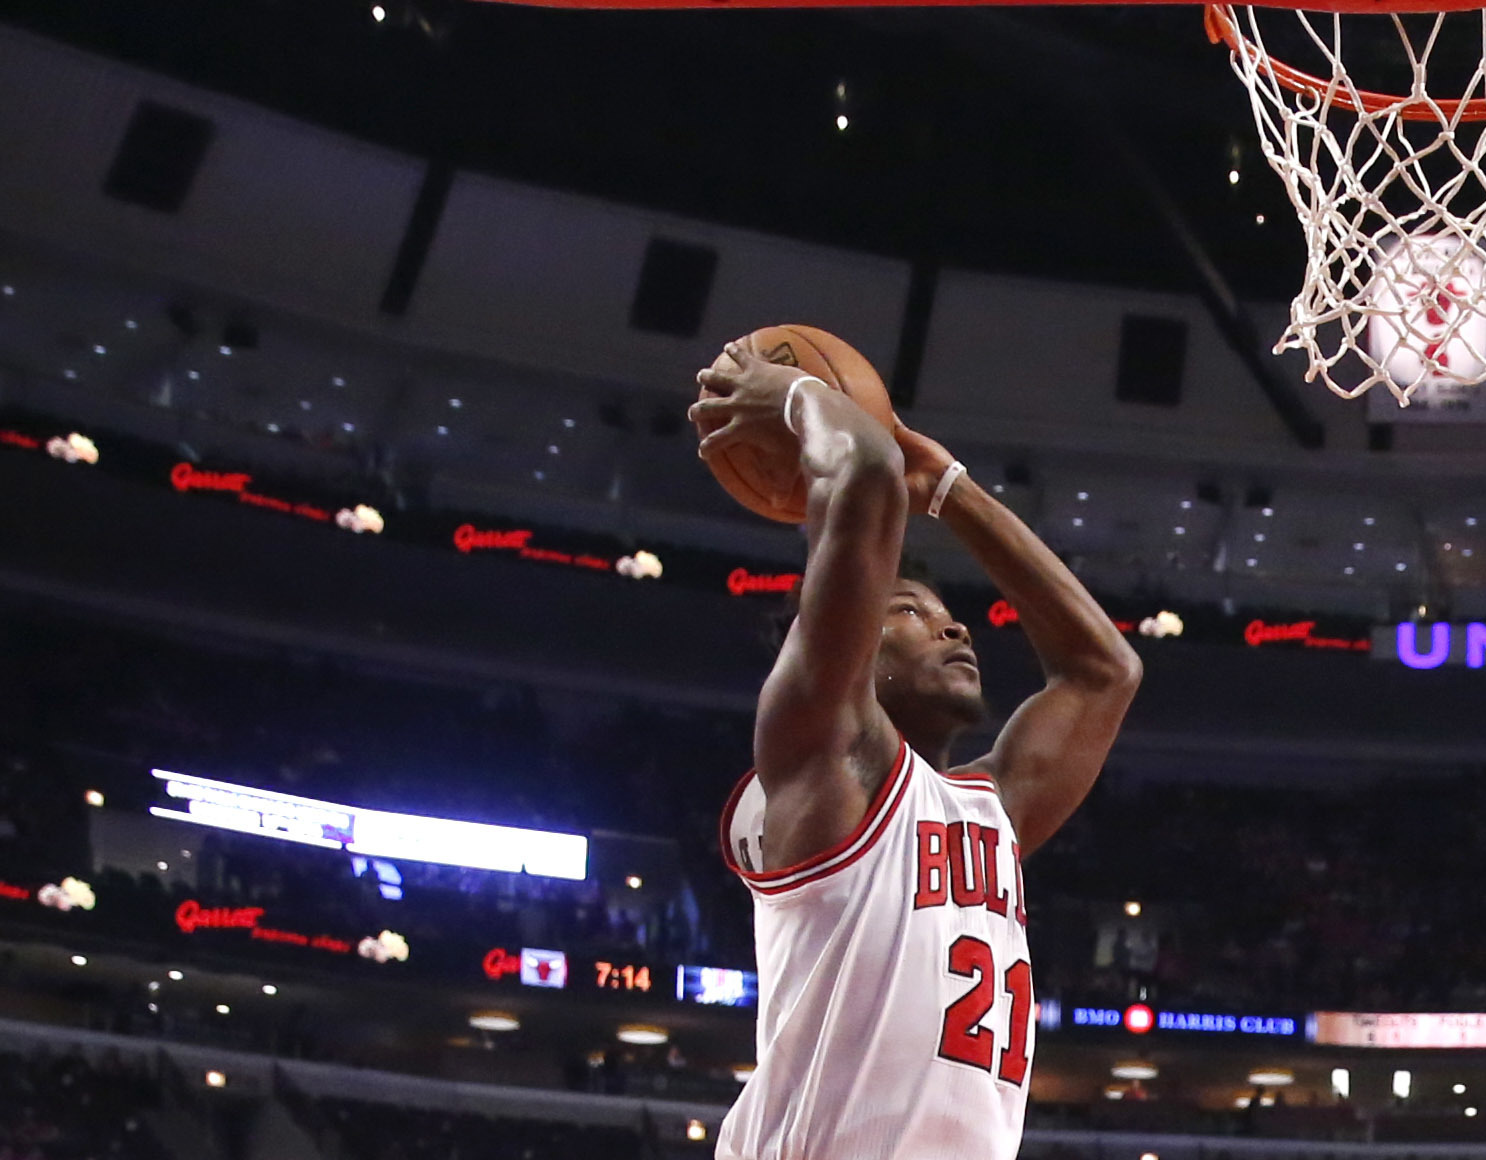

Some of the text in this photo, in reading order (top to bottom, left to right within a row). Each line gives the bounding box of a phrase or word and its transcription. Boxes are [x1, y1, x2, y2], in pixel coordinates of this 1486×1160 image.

[914, 820, 1028, 927] BULL
[595, 961, 652, 992] 7:14
[937, 934, 1031, 1087] 21
[1074, 1007, 1295, 1036] BMO HARRIS CLUB
